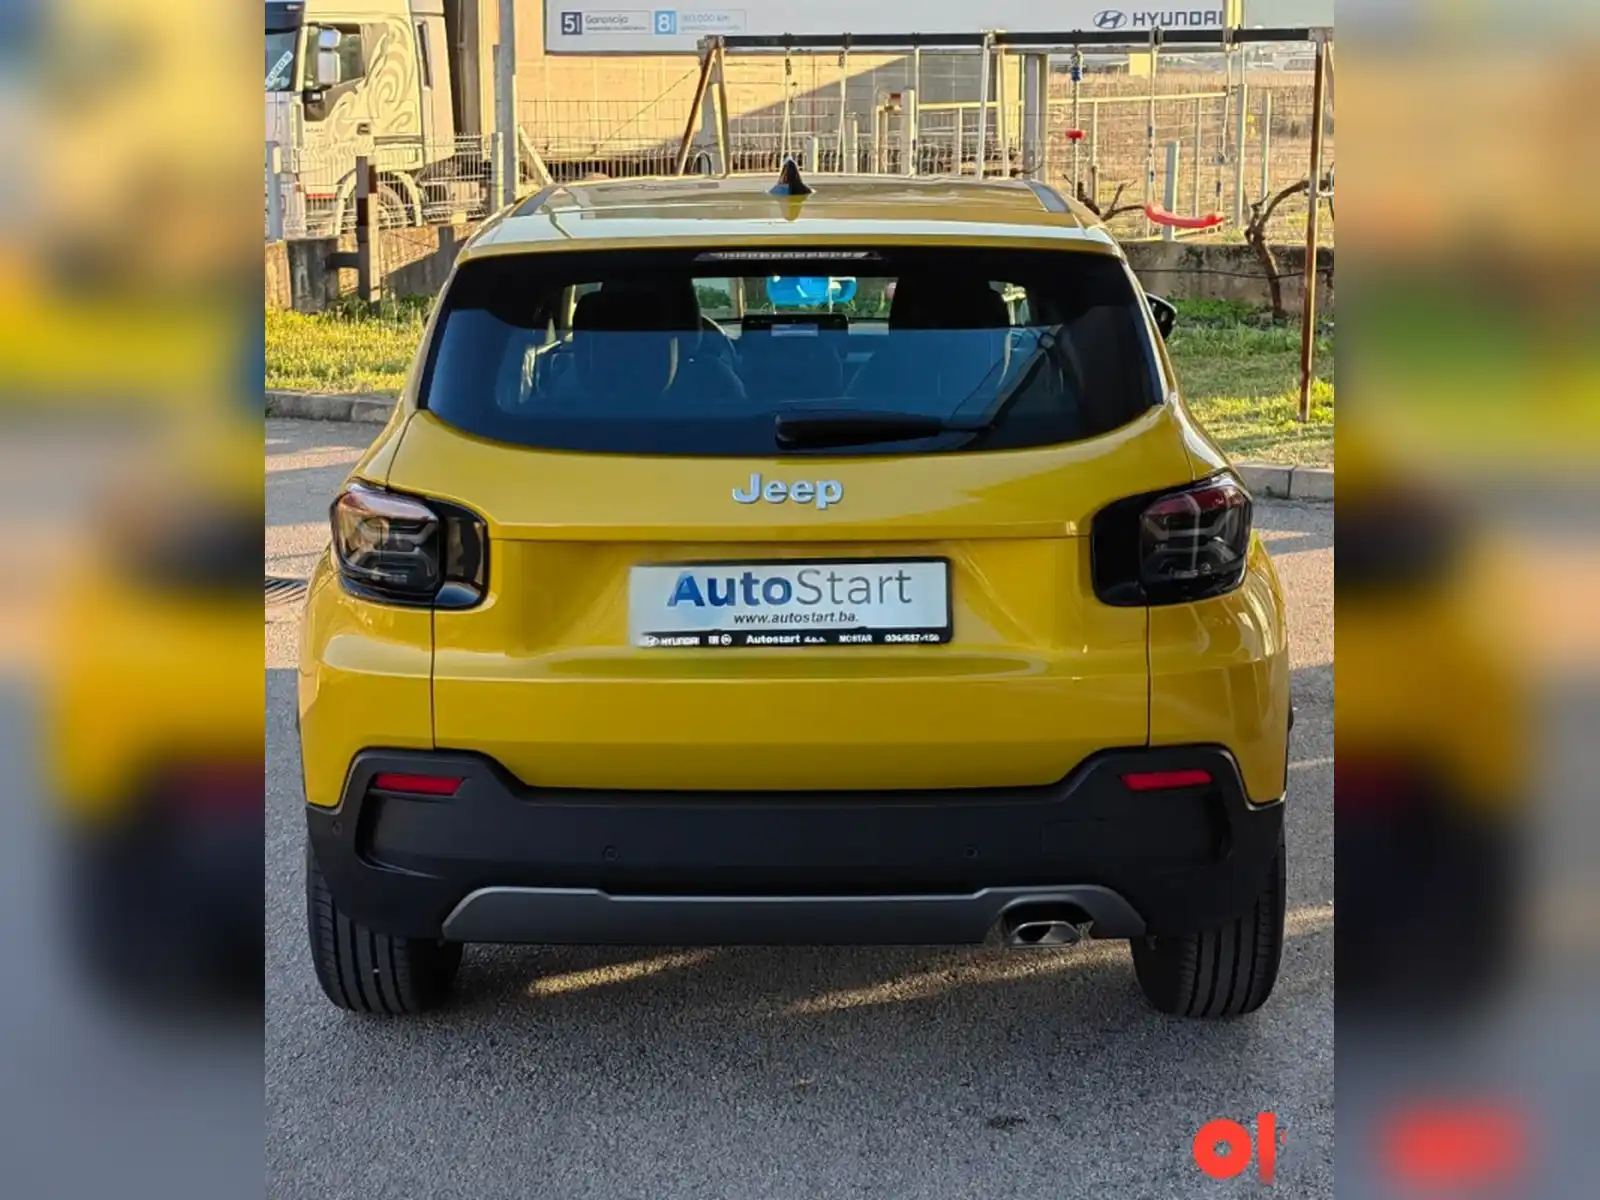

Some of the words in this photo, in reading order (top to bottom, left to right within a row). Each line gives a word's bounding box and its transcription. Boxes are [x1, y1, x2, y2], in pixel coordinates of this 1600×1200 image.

[1132, 11, 1223, 26] HYUNDAI
[732, 473, 844, 510] Jeep
[667, 568, 912, 608] AutoStart
[746, 634, 800, 645] Autostart
